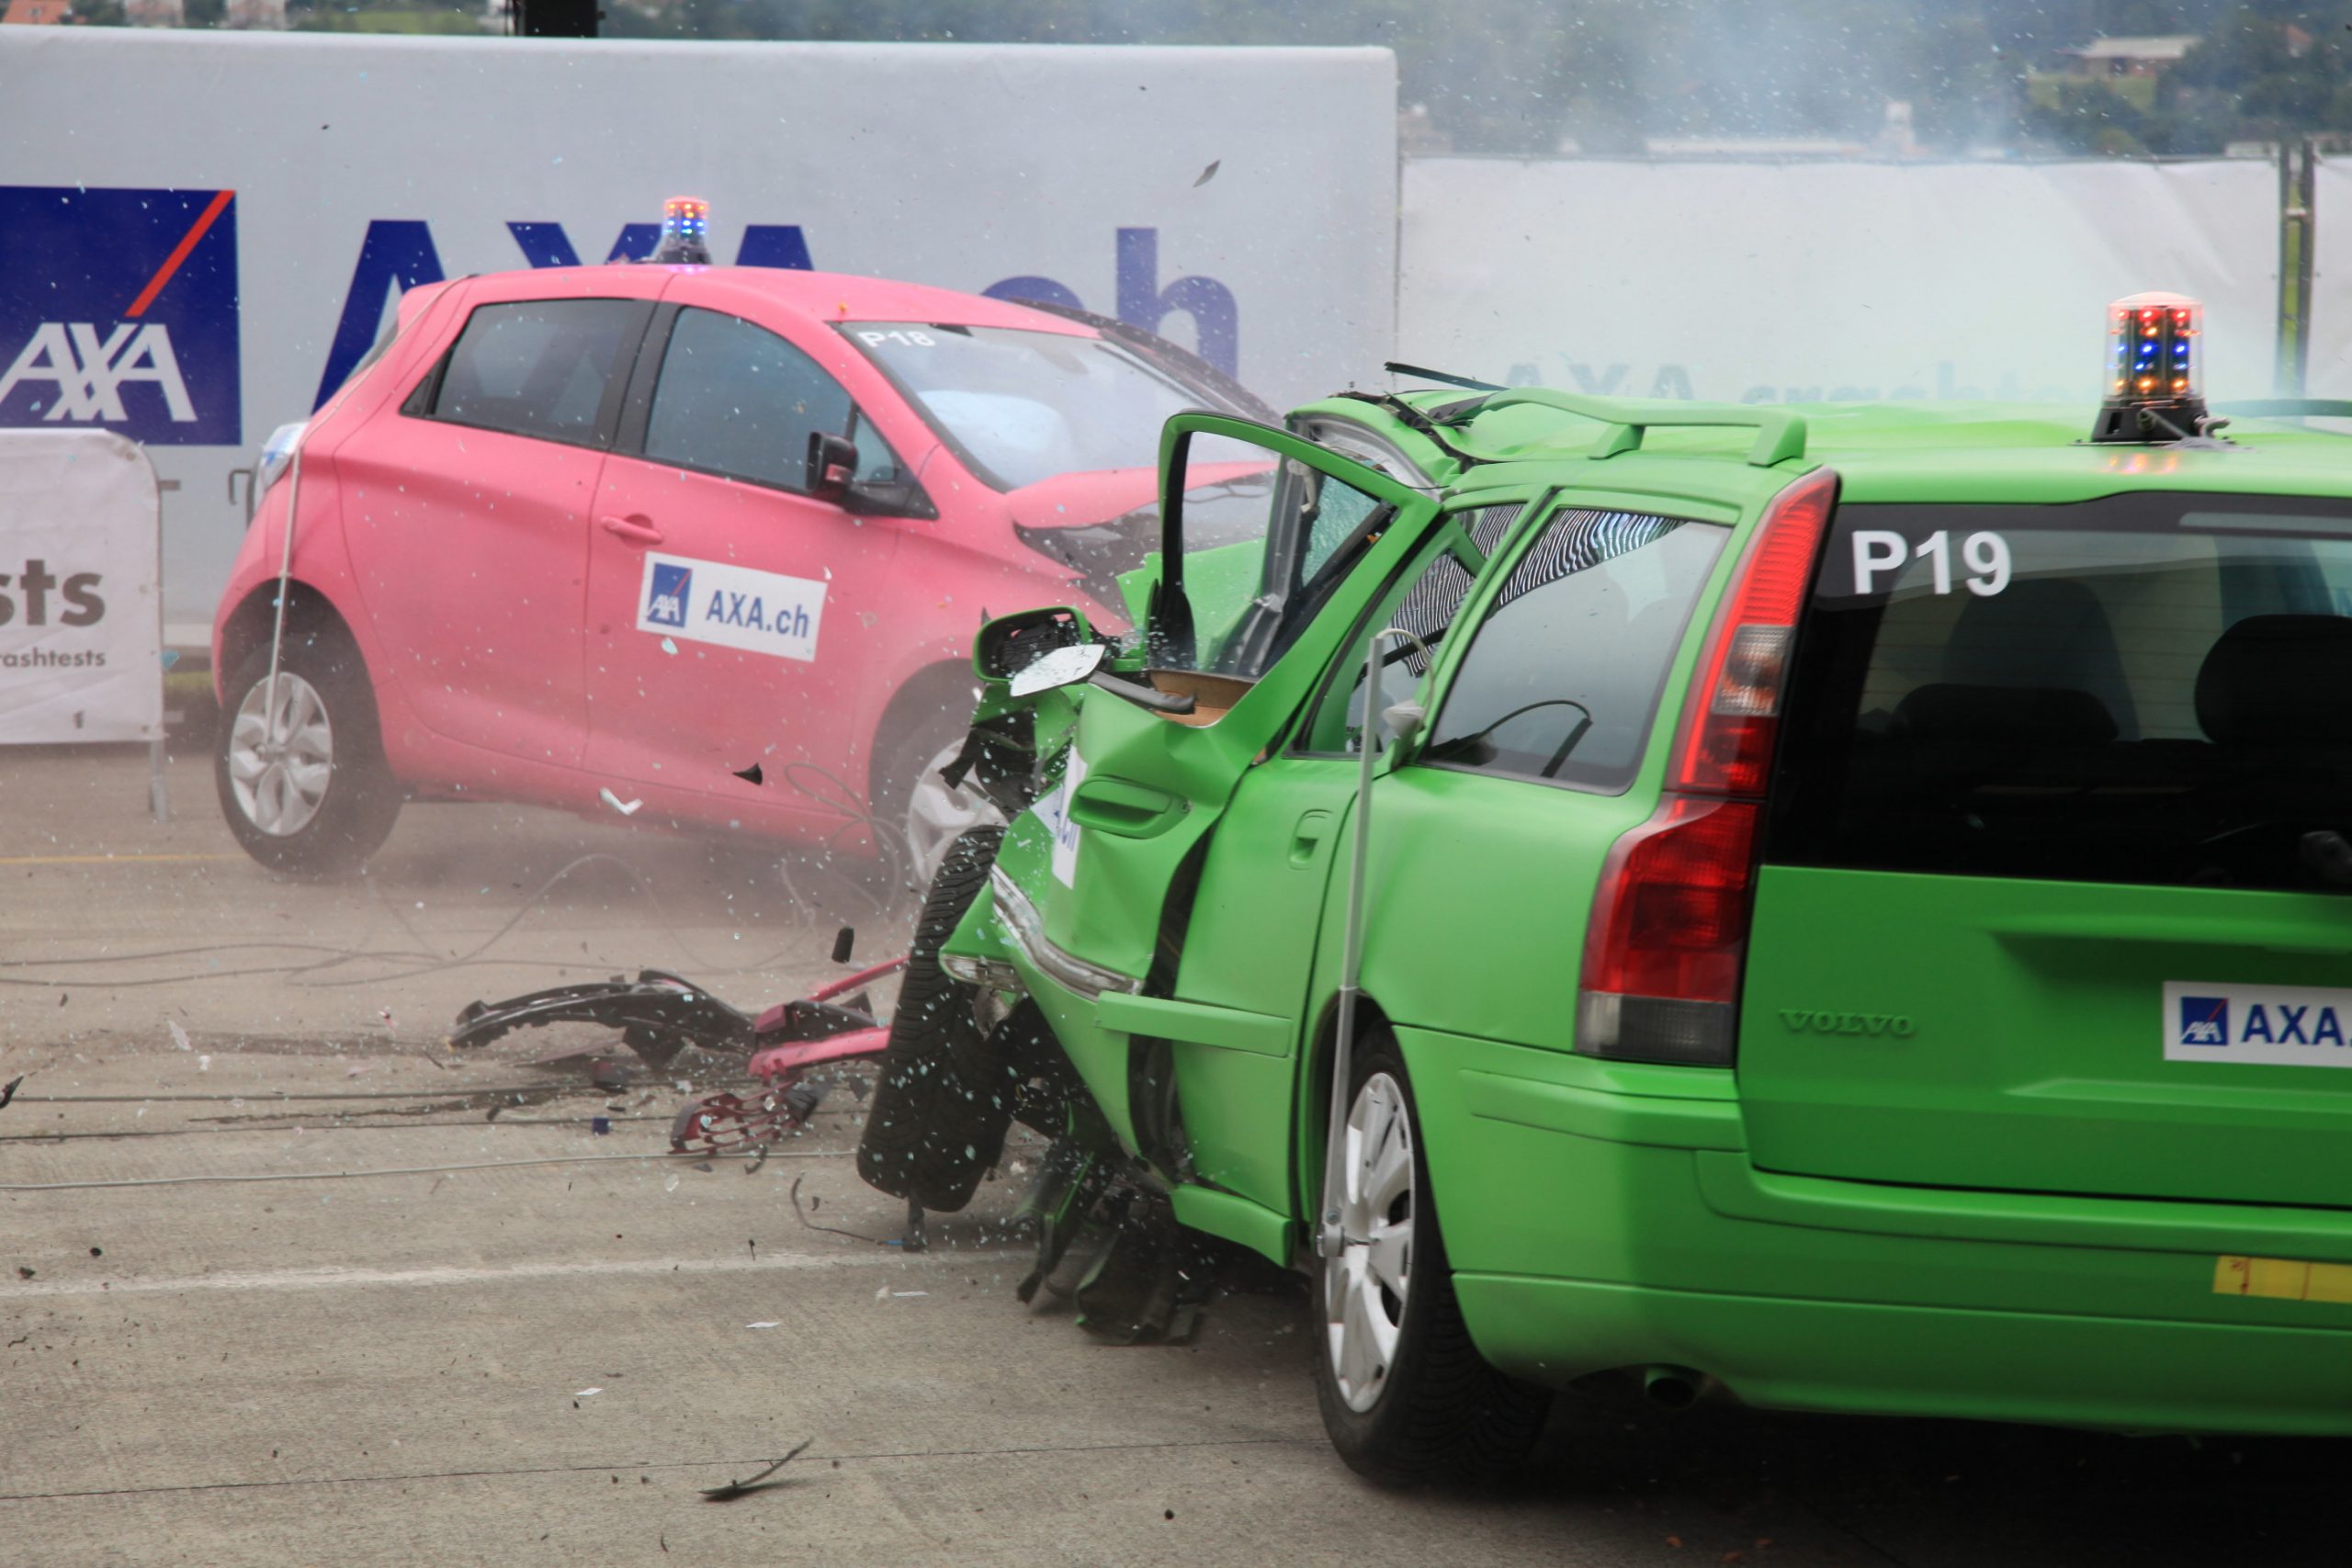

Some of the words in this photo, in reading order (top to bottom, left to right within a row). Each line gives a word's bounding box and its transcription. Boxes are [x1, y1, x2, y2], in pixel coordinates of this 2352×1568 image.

[857, 331, 935, 347] P18
[0, 322, 198, 422] AXA
[1852, 530, 2012, 596] P19
[706, 590, 809, 639] AXA.ch
[0, 647, 106, 668] ashtests
[1778, 1010, 1916, 1038] VOLVO
[2181, 1021, 2222, 1043] AXA
